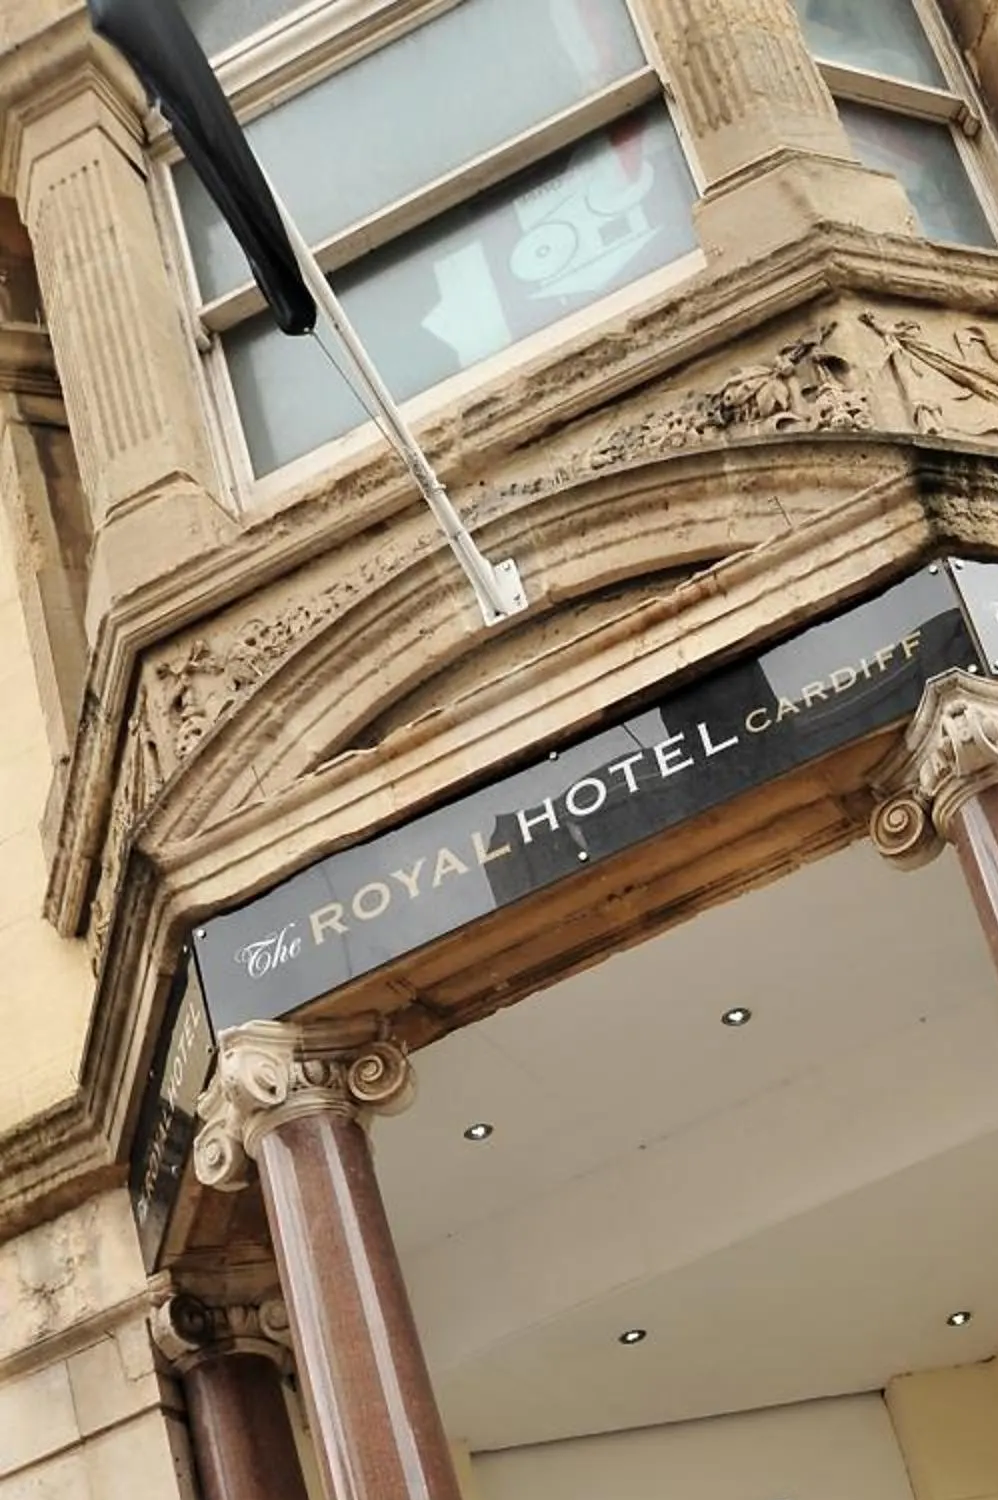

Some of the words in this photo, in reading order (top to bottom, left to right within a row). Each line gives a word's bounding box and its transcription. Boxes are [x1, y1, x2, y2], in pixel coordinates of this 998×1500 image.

[234, 922, 302, 979] The
[309, 831, 512, 945] ROYAL
[516, 721, 739, 844] HOTEL
[745, 630, 922, 733] CARDIFF
